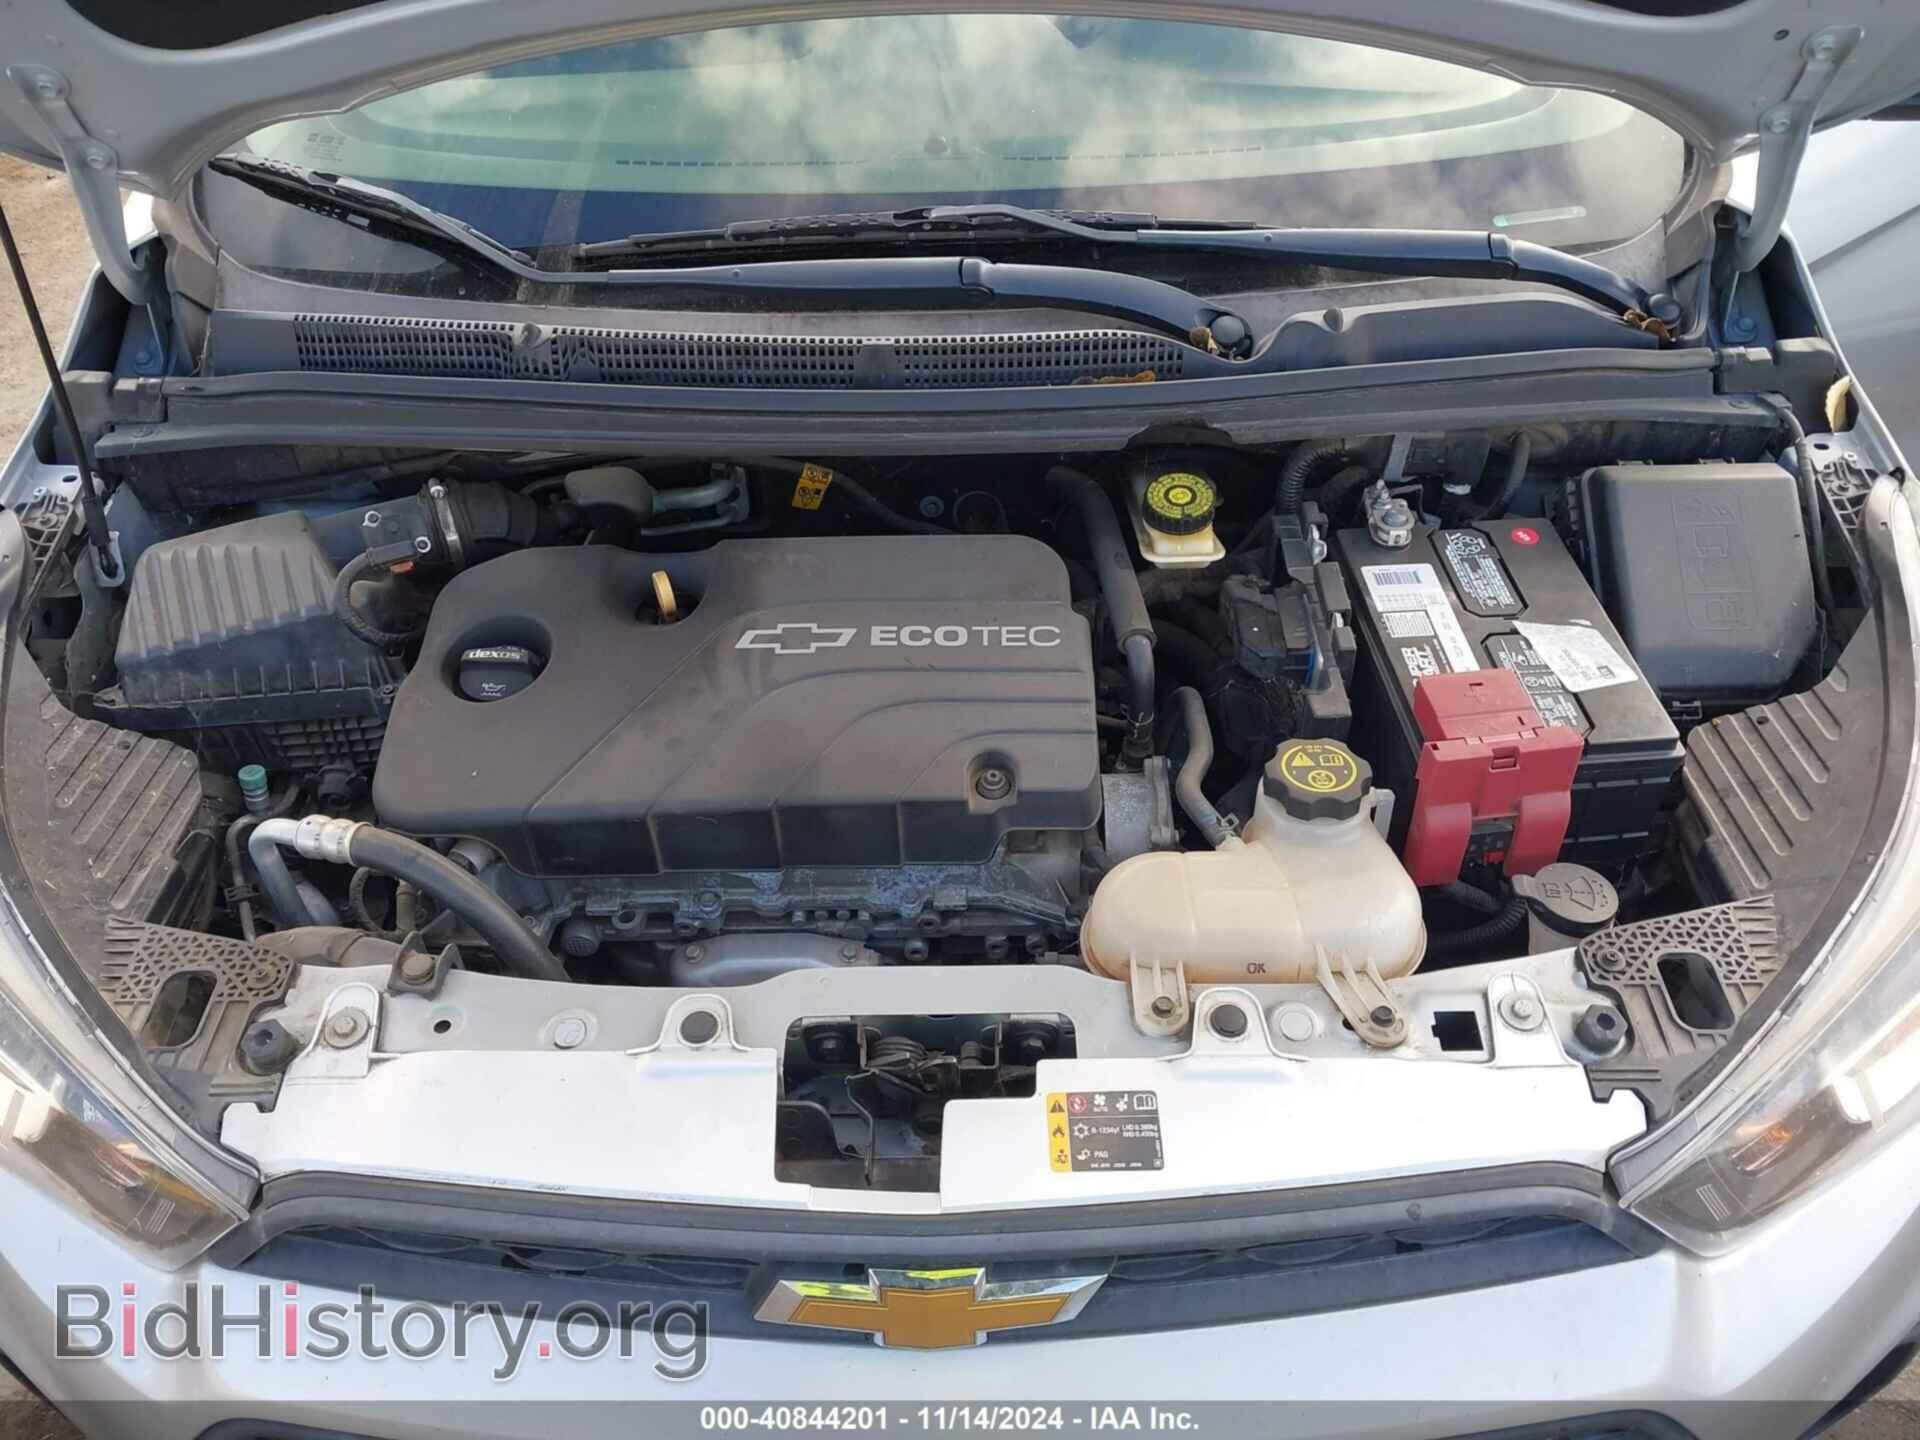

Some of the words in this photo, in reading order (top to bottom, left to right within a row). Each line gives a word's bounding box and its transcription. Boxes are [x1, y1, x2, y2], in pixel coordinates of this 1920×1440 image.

[870, 625, 1061, 647] ECOTEC
[469, 649, 520, 660] dexos
[1247, 962, 1266, 975] OK
